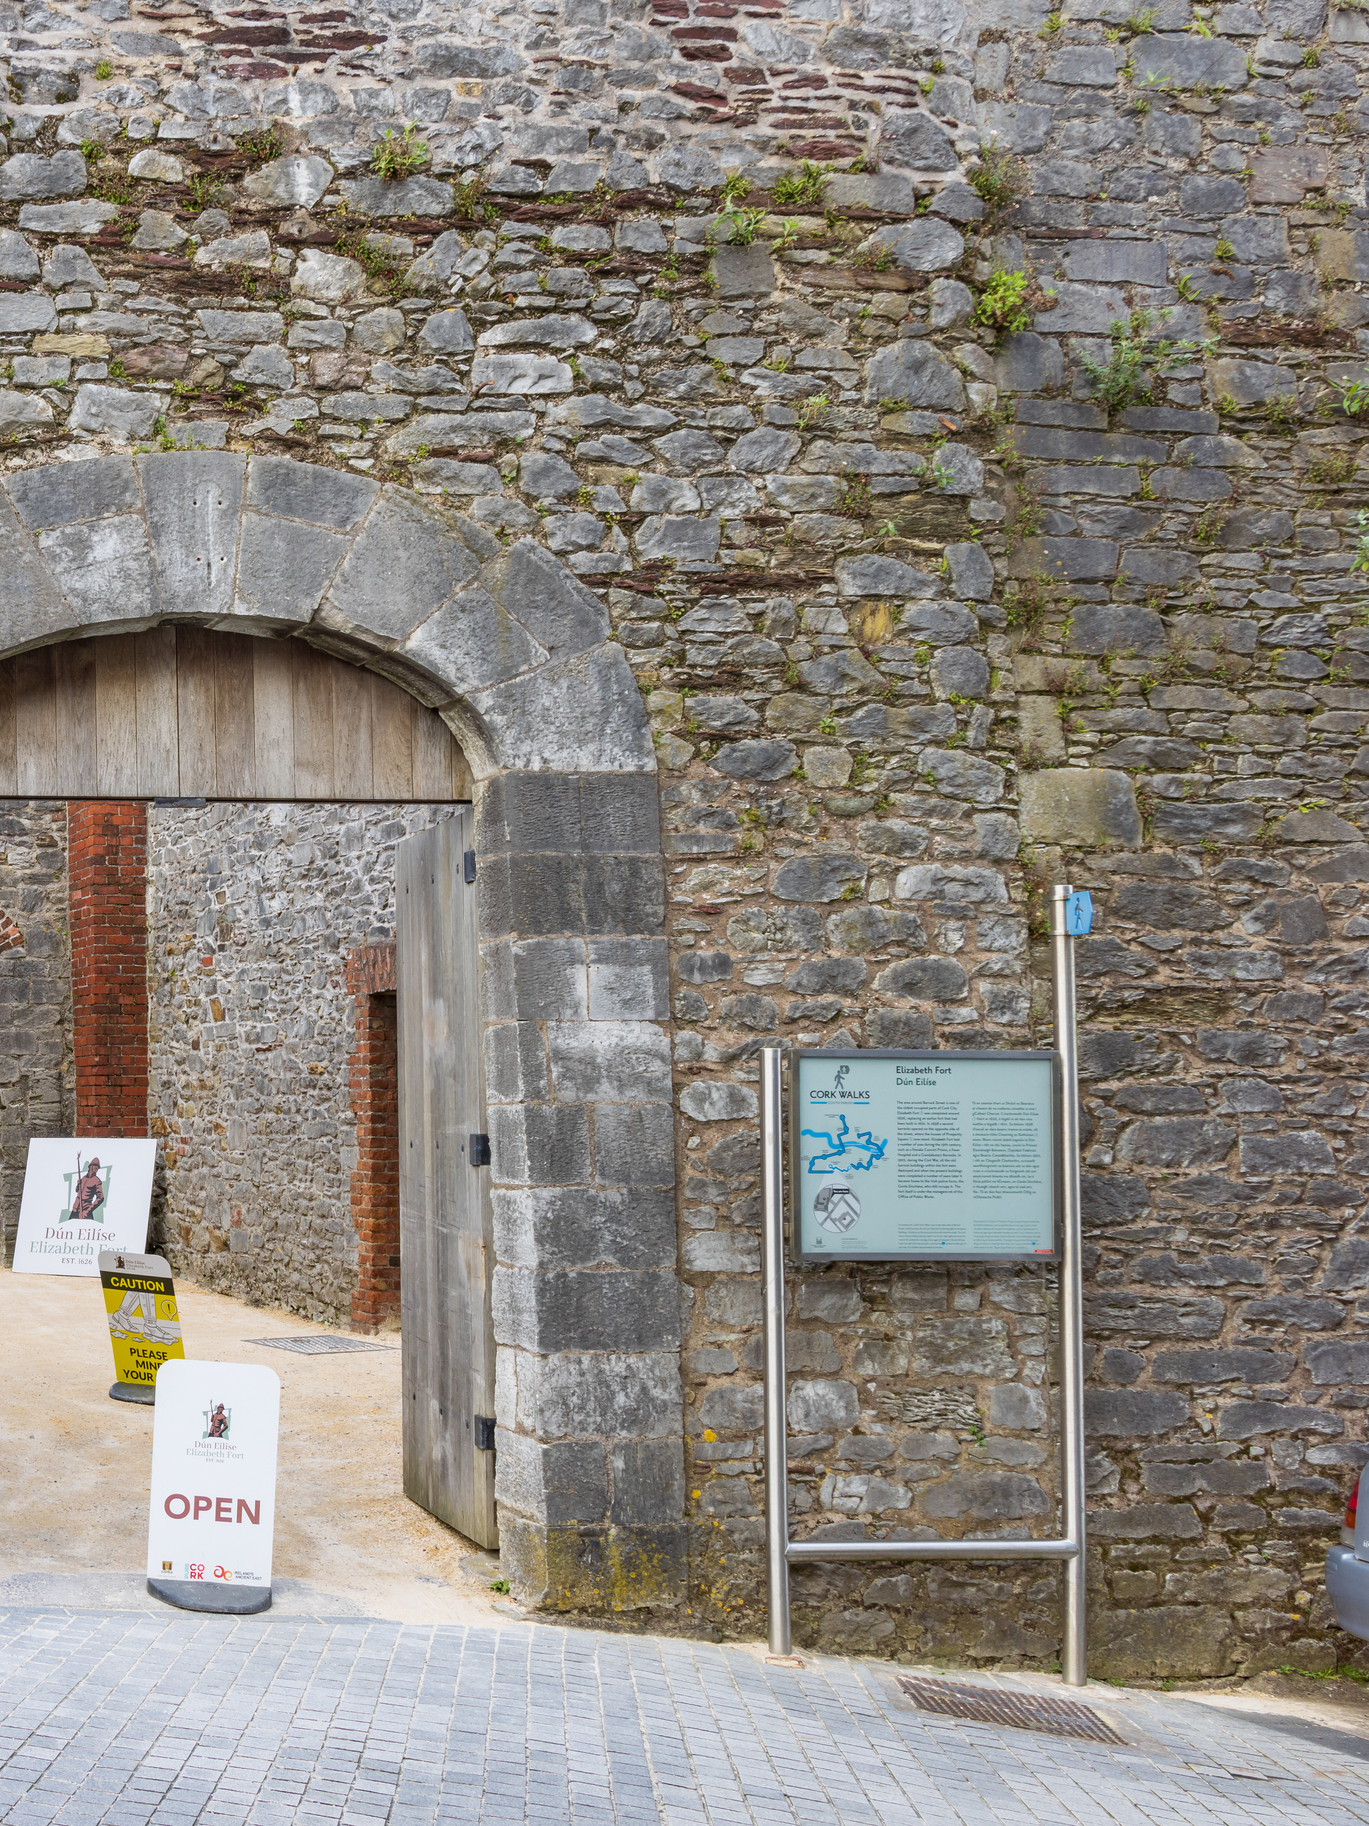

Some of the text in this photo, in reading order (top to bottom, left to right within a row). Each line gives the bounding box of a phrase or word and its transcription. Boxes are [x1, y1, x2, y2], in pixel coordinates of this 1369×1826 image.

[896, 1066, 951, 1074] Elizabeth Fort
[810, 1090, 870, 1099] CORK WALKS
[44, 1227, 116, 1241] Dún Eilíse
[30, 1241, 93, 1255] Elizabeth
[110, 1277, 165, 1292] CAUTION
[130, 1348, 168, 1360] PLEASE
[123, 1369, 154, 1382] YOUR
[186, 1448, 225, 1458] Elizabeth
[164, 1493, 261, 1525] OPEN
[190, 1563, 205, 1572] CO
[190, 1572, 204, 1580] RK
